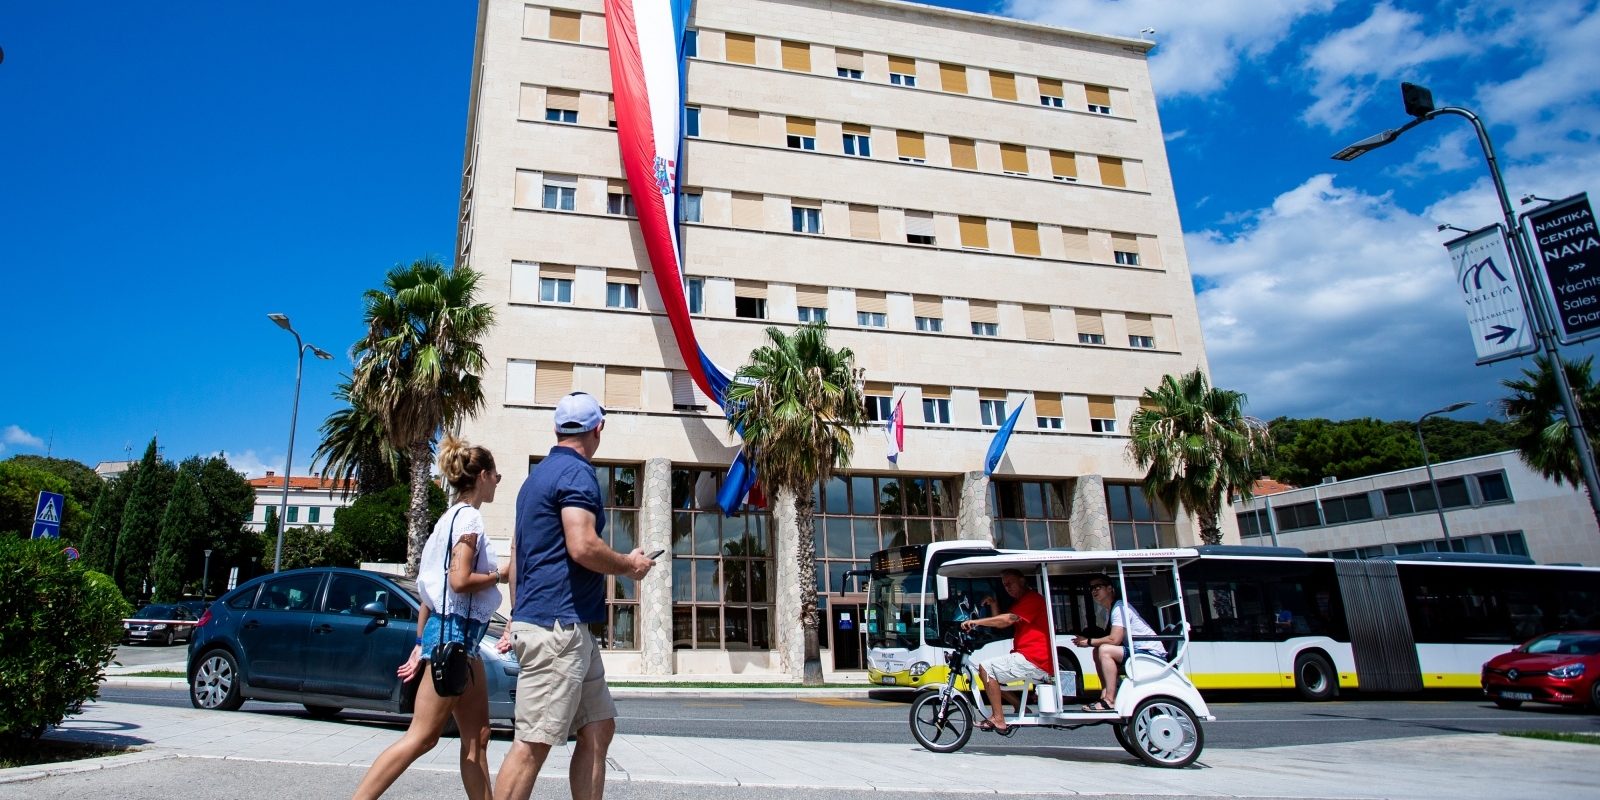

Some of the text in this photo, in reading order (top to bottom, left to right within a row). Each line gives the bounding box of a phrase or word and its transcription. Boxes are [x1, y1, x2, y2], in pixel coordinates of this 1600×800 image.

[1535, 210, 1590, 232] NAUTIKA
[1540, 222, 1594, 245] CENTAR
[1544, 237, 1600, 262] NAVA
[1563, 295, 1597, 310] Sales
